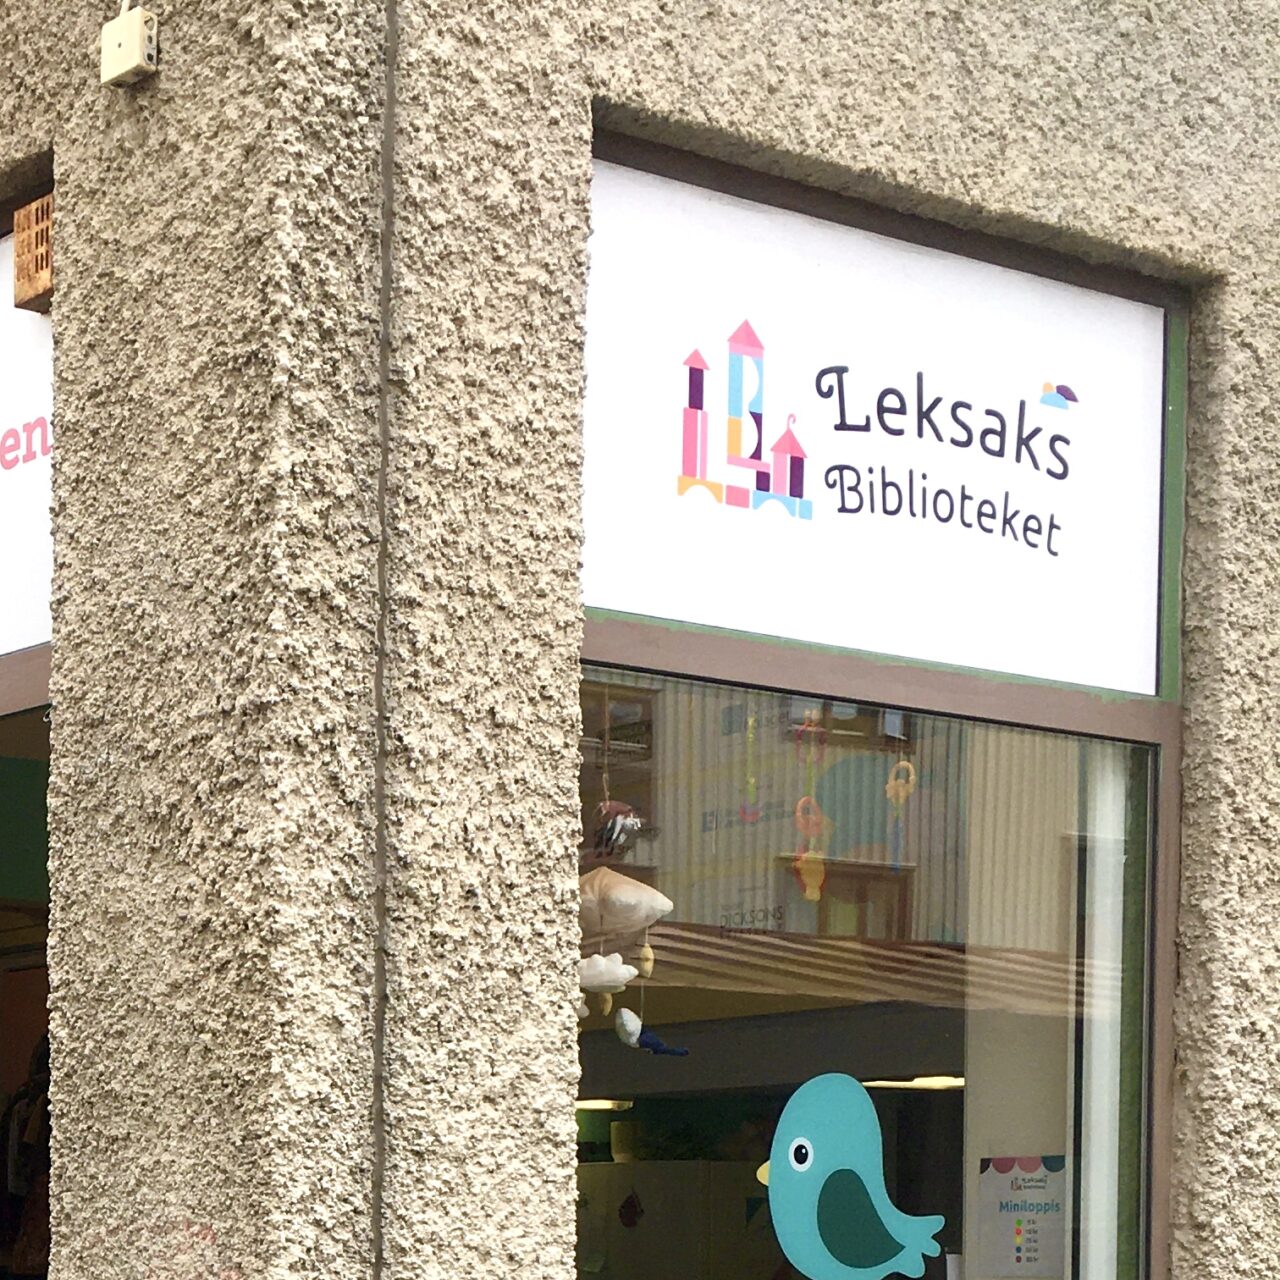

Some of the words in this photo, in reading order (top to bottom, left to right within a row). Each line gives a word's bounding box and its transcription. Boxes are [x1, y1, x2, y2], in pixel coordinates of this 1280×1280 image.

[816, 366, 1071, 480] Leksaks
[824, 464, 1061, 556] Biblioteket
[999, 1200, 1060, 1214] Miniloppis
